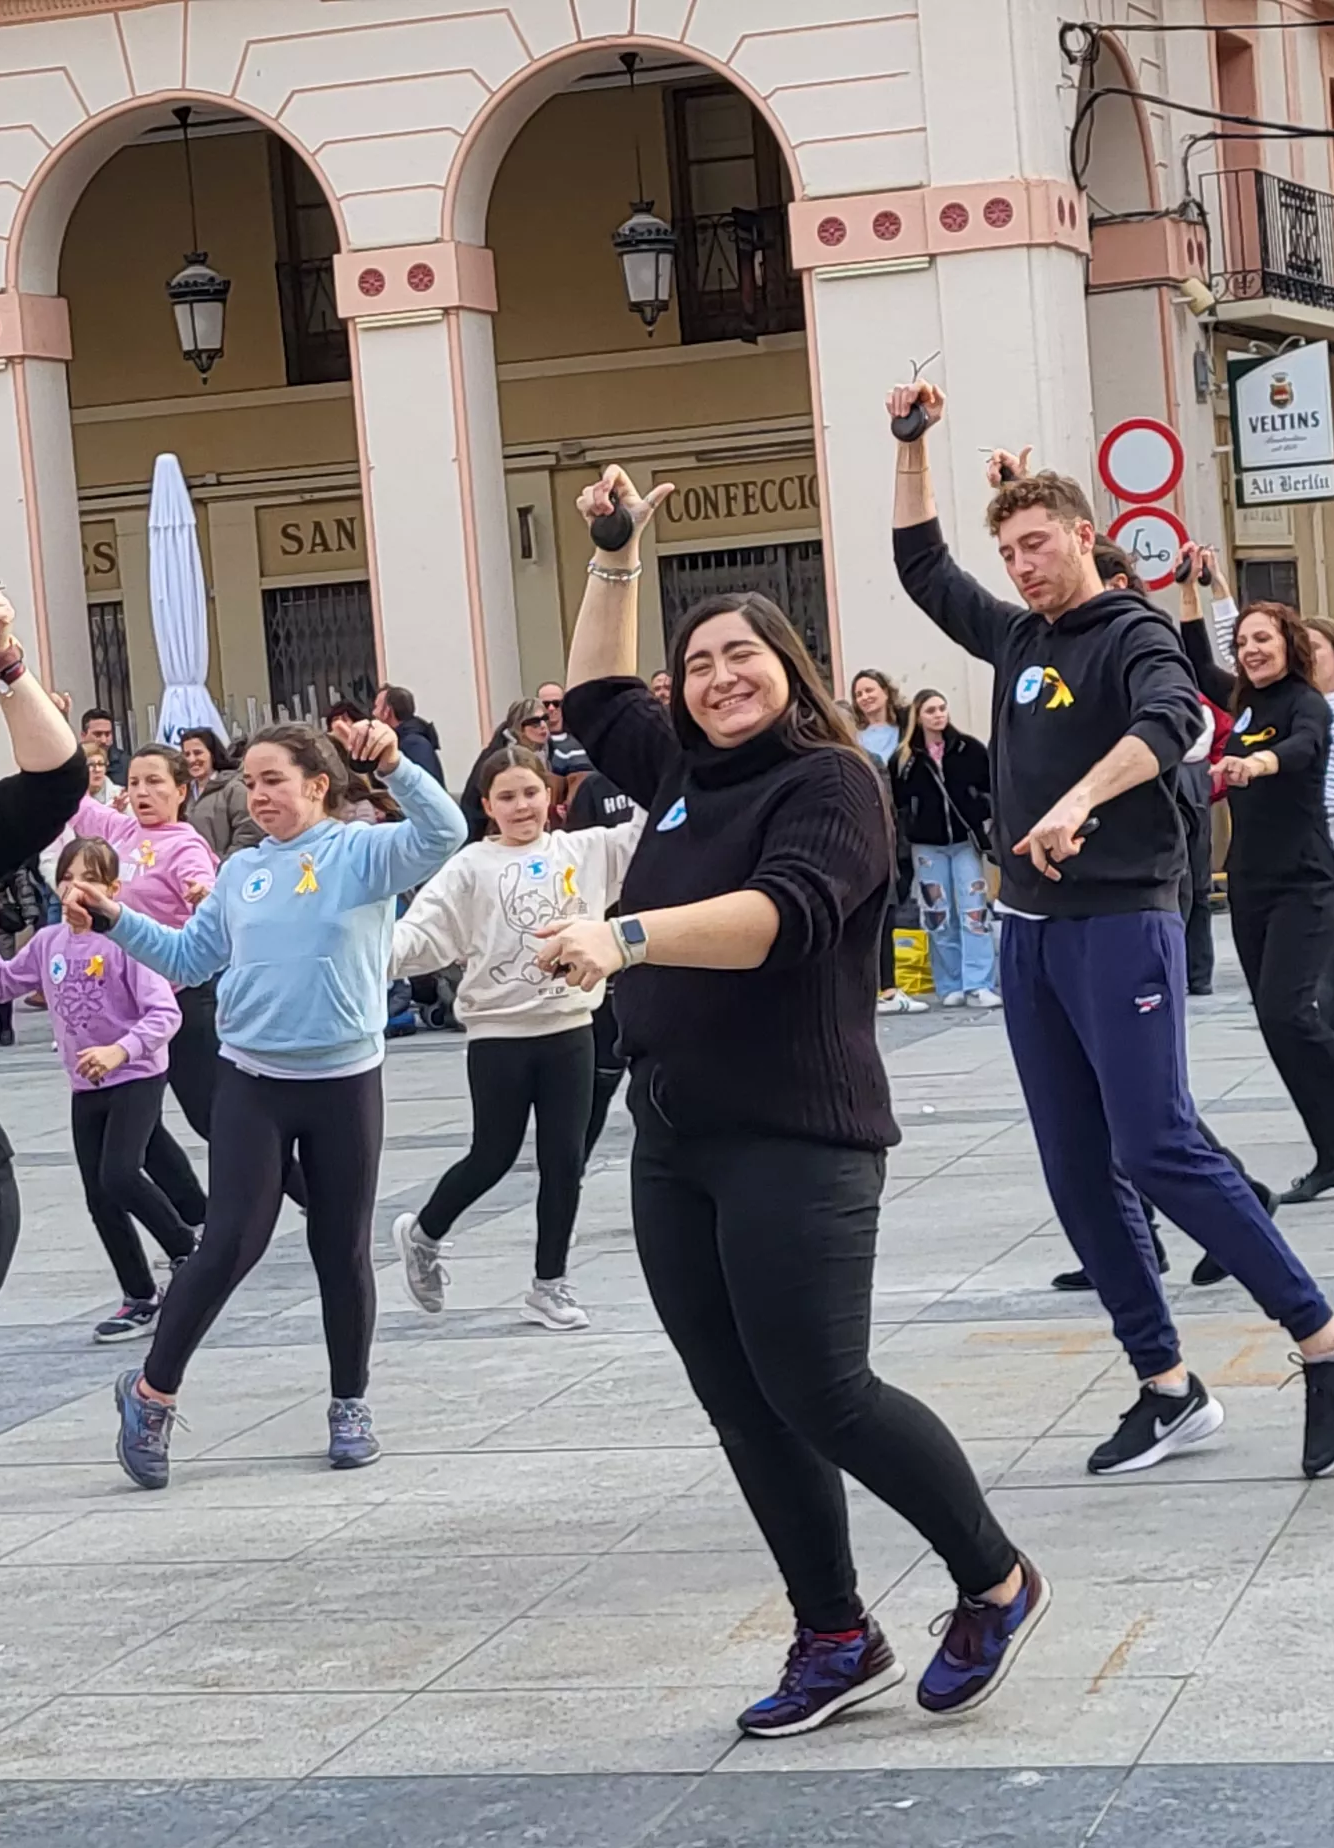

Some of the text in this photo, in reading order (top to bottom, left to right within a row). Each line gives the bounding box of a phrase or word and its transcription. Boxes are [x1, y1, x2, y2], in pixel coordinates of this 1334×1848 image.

[1248, 411, 1320, 434] VELTINS
[1250, 477, 1274, 495] Alt
[280, 516, 357, 556] SAN
